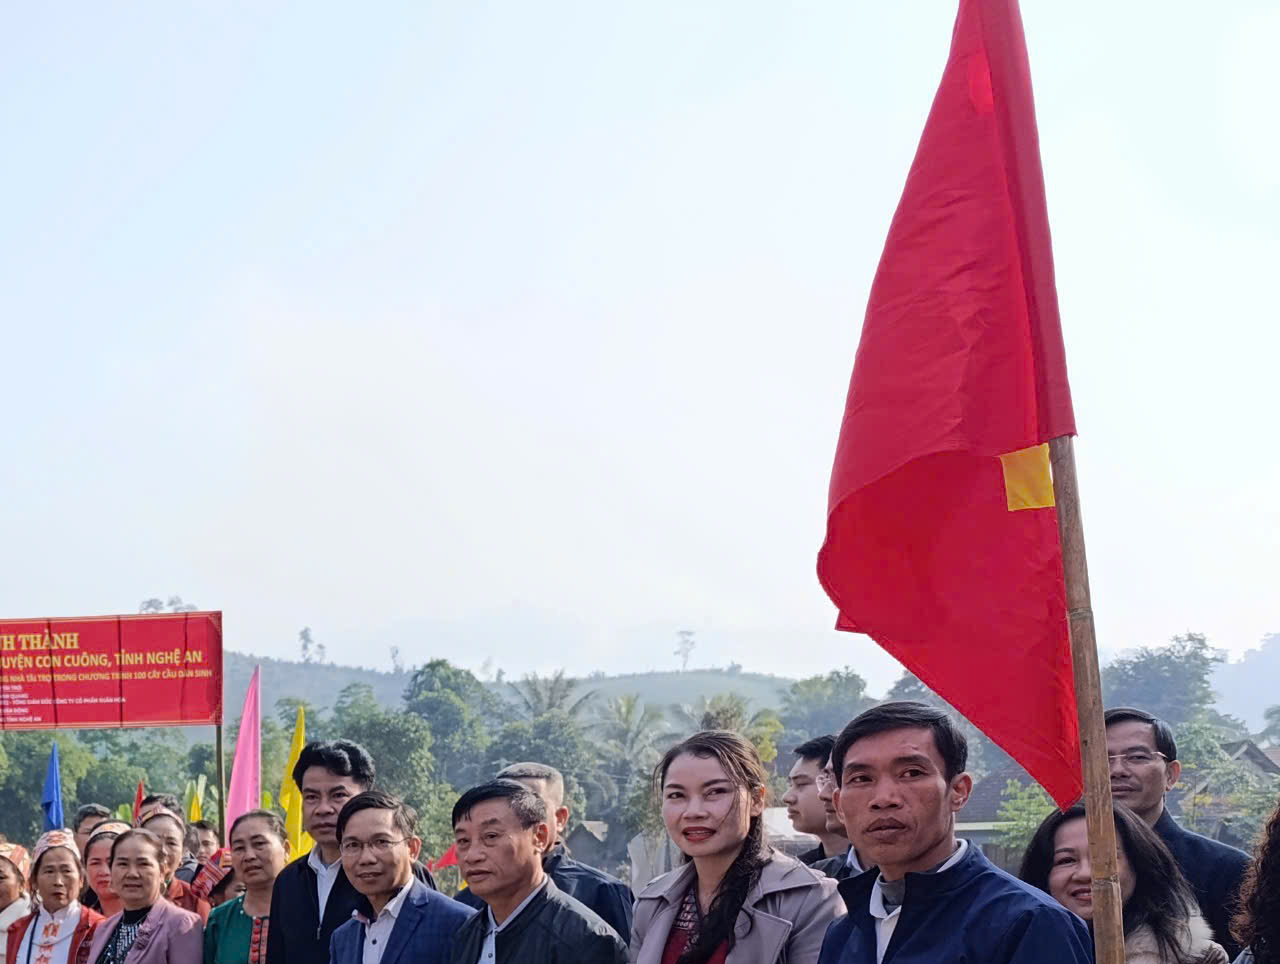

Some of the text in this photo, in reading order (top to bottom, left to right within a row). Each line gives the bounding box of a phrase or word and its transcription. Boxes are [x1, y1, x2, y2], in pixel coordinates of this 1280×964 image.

[18, 628, 79, 650] THÀNH
[35, 656, 61, 668] CON
[64, 651, 112, 668] CUÔNG,
[146, 648, 181, 666] NGHỆ
[184, 650, 202, 664] AN
